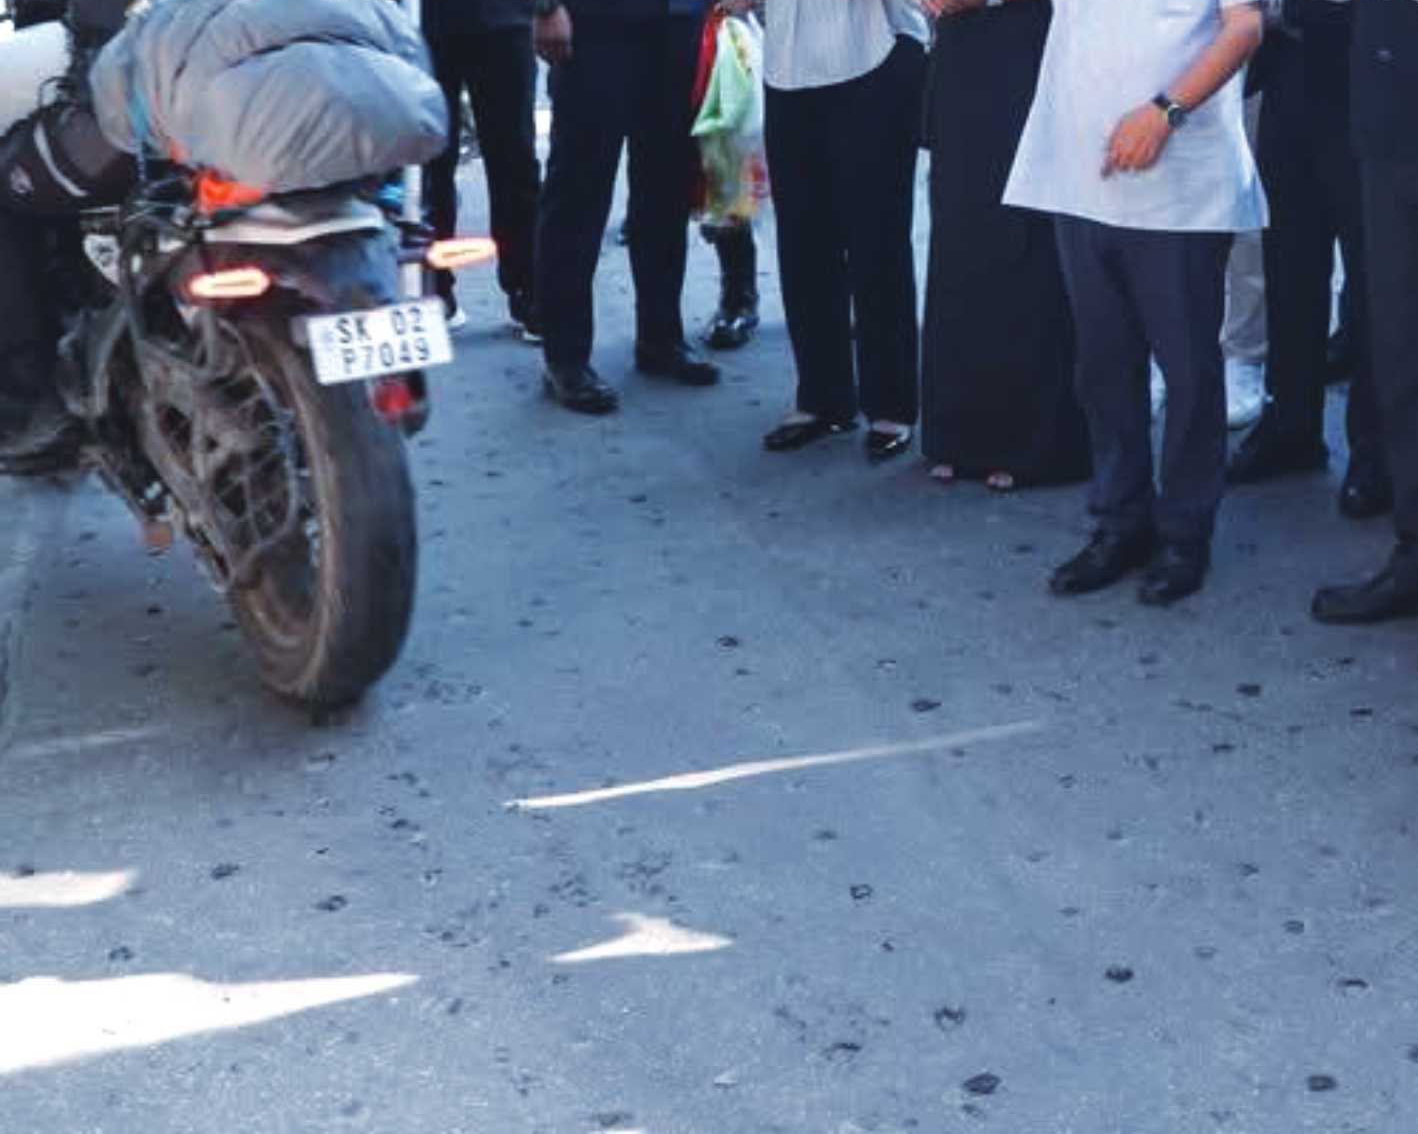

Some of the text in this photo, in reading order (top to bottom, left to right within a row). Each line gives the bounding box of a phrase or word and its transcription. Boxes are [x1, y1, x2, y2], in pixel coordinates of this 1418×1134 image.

[336, 306, 426, 344] SK 02
[341, 337, 430, 374] P7049
